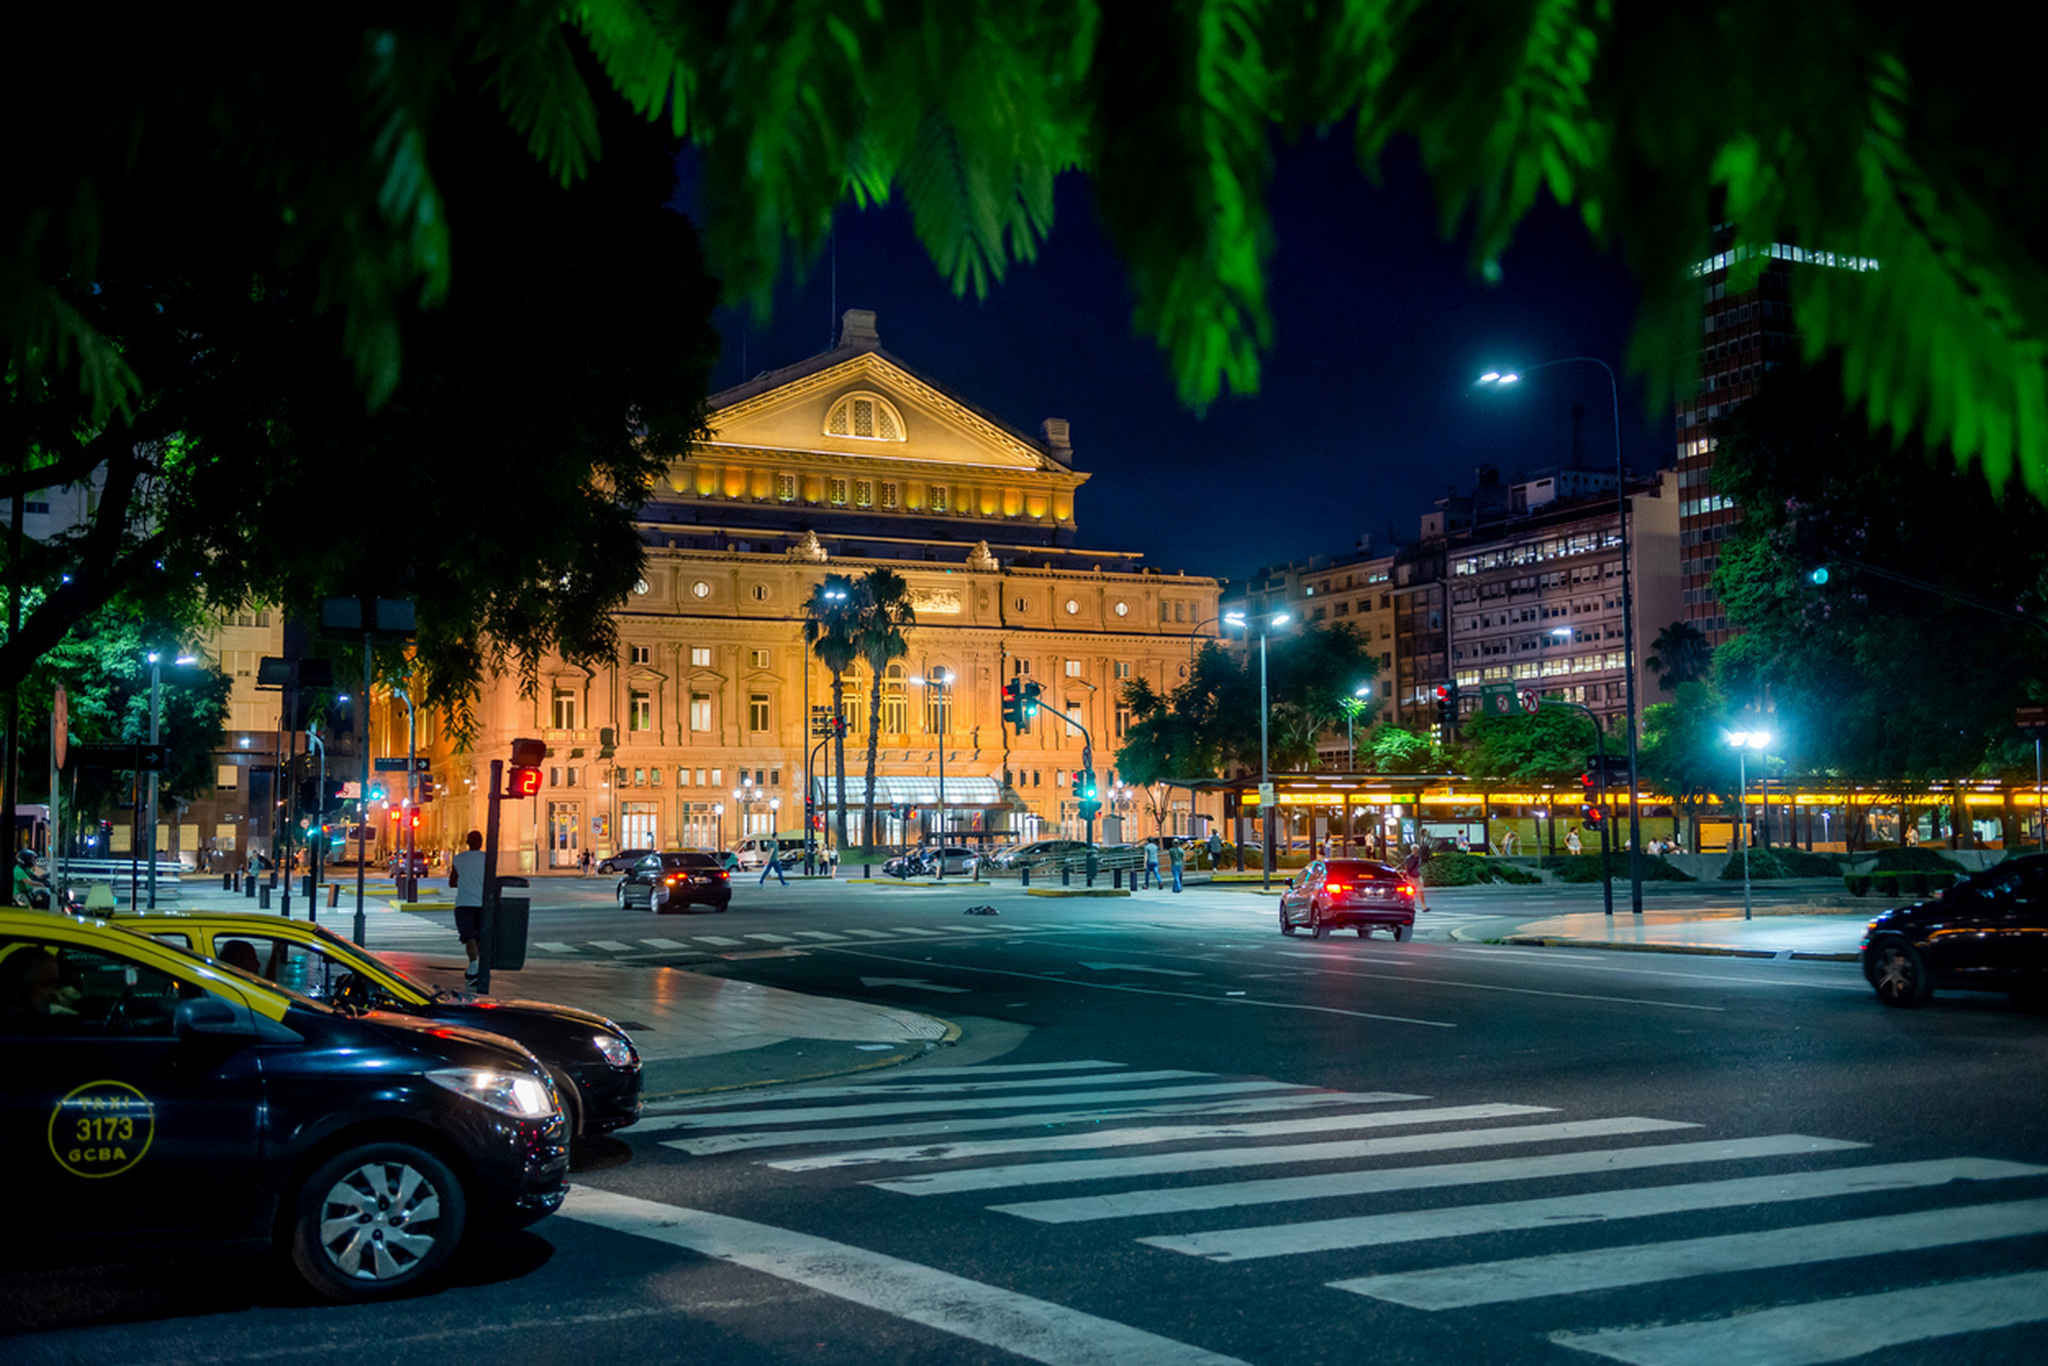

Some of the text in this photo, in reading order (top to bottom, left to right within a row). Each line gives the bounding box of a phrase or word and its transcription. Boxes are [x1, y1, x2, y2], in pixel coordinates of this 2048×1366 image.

[523, 770, 536, 793] 2
[78, 1096, 130, 1111] TAXI
[76, 1116, 133, 1142] 3173
[68, 1146, 127, 1163] GCBA
